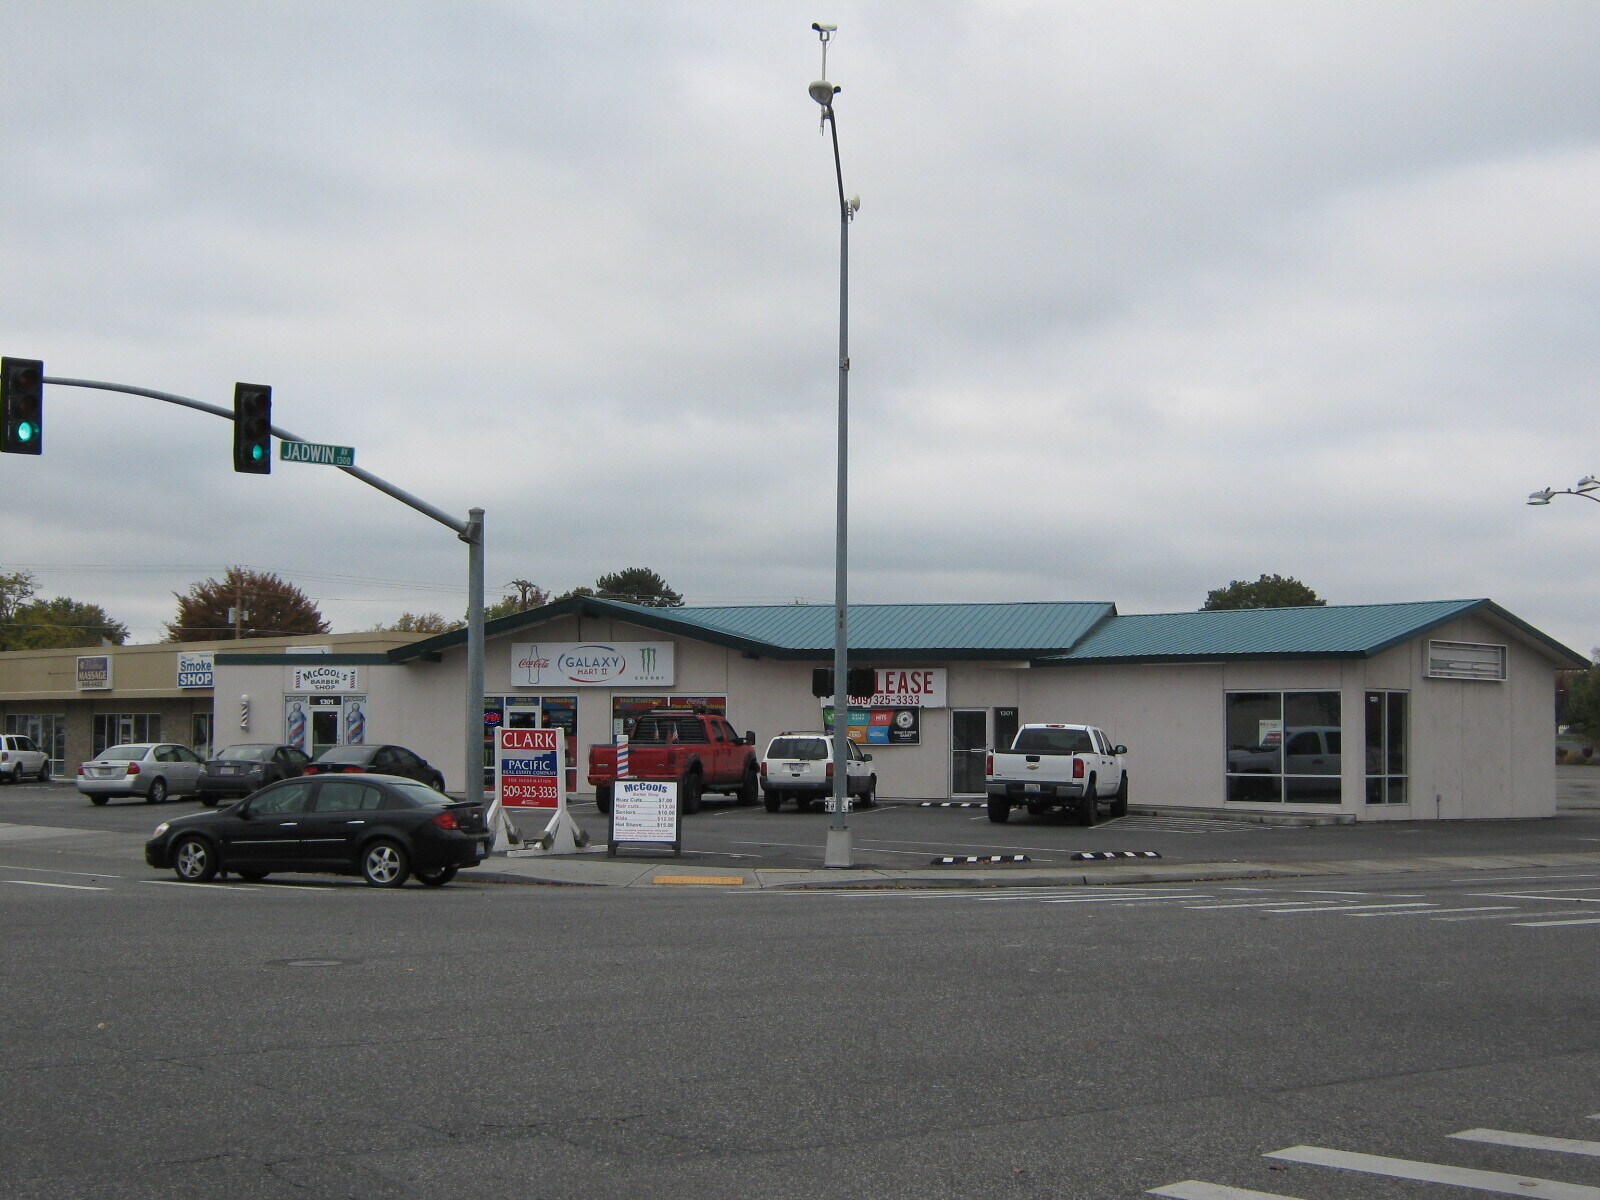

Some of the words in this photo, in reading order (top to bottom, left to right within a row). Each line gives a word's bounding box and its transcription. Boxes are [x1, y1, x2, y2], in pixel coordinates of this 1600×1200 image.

[283, 443, 335, 464] JADWIN
[336, 456, 351, 465] 1300
[180, 660, 212, 671] Smoke
[565, 657, 620, 668] GALAXY
[79, 671, 106, 680] MASSAGE
[180, 673, 211, 685] SHOP
[874, 671, 934, 694] LEASE
[503, 732, 555, 748] CLARK
[508, 760, 551, 771] PACIFIC
[503, 785, 557, 798] 509-325-3333
[624, 783, 668, 793] McCools
